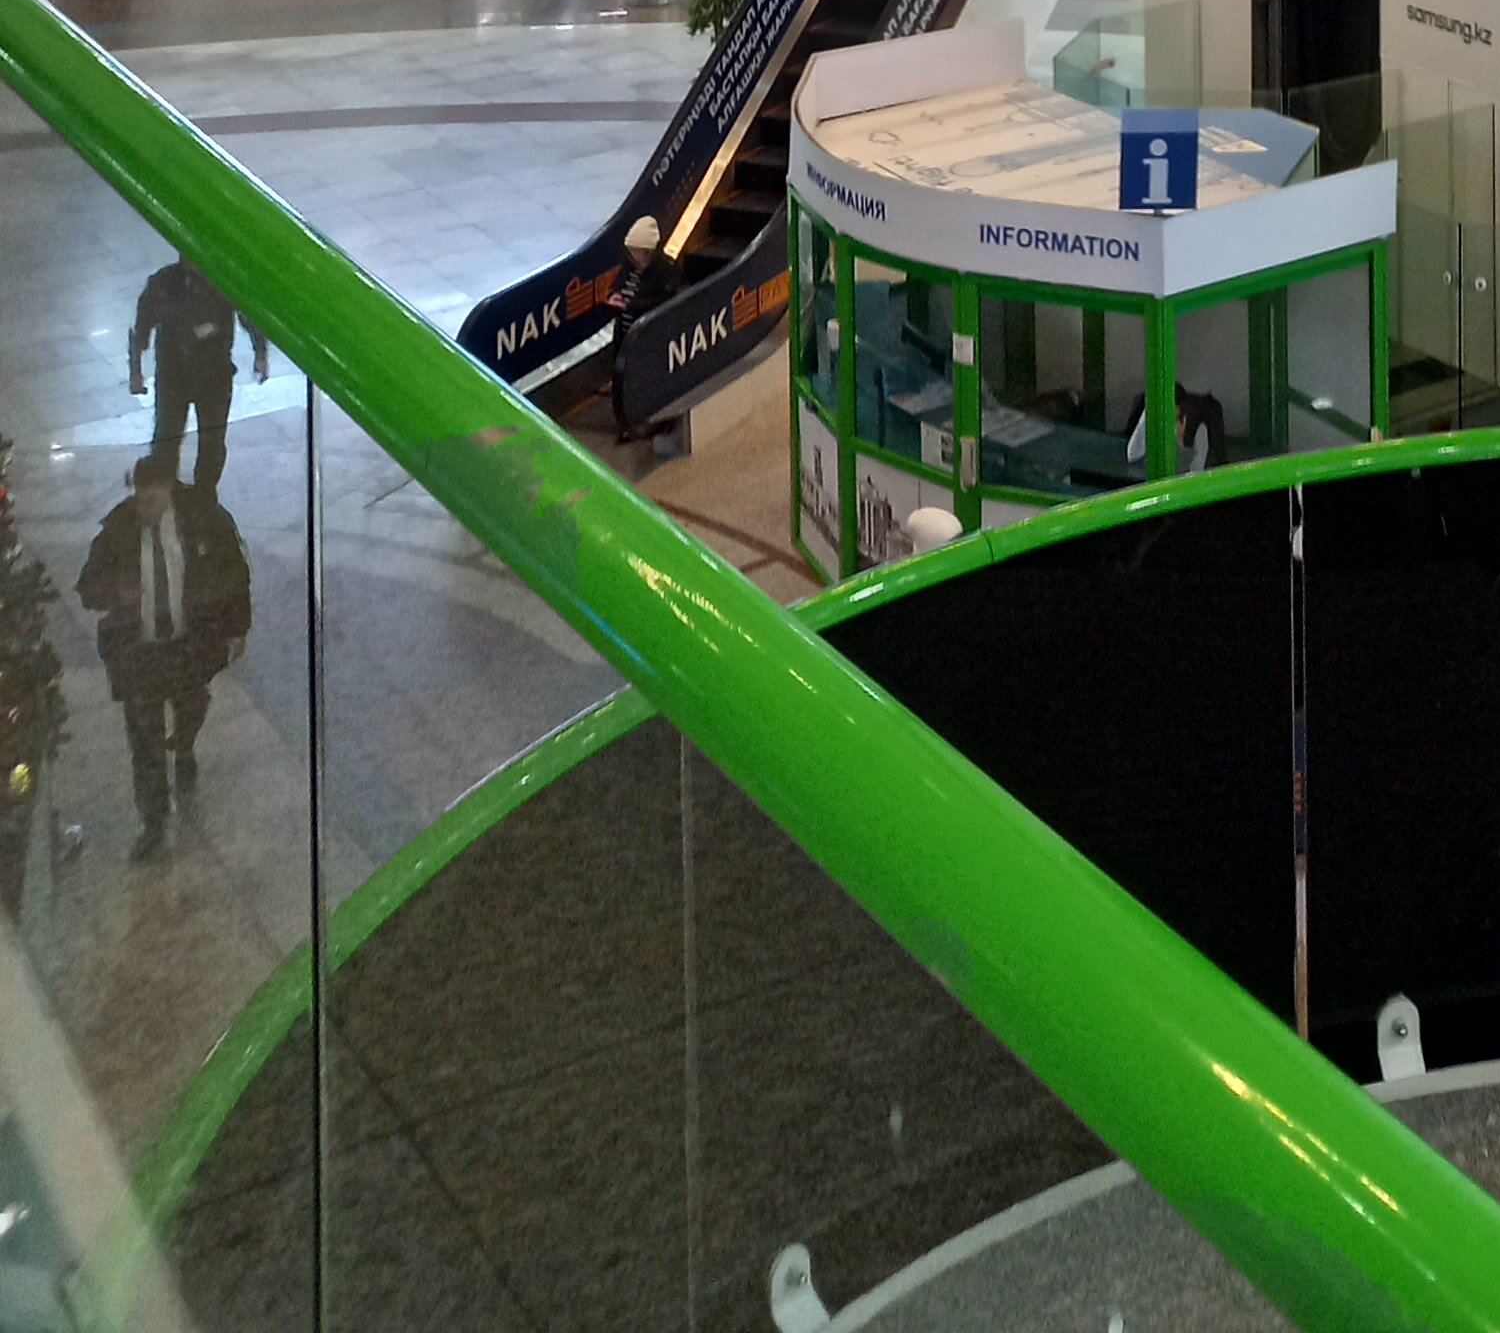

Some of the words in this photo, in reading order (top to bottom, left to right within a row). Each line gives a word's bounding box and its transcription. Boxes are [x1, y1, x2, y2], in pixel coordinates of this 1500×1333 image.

[1406, 4, 1493, 47] samsung.kz
[978, 222, 1141, 263] INFORMATION
[496, 295, 563, 361] NAK
[667, 305, 729, 374] NAK
